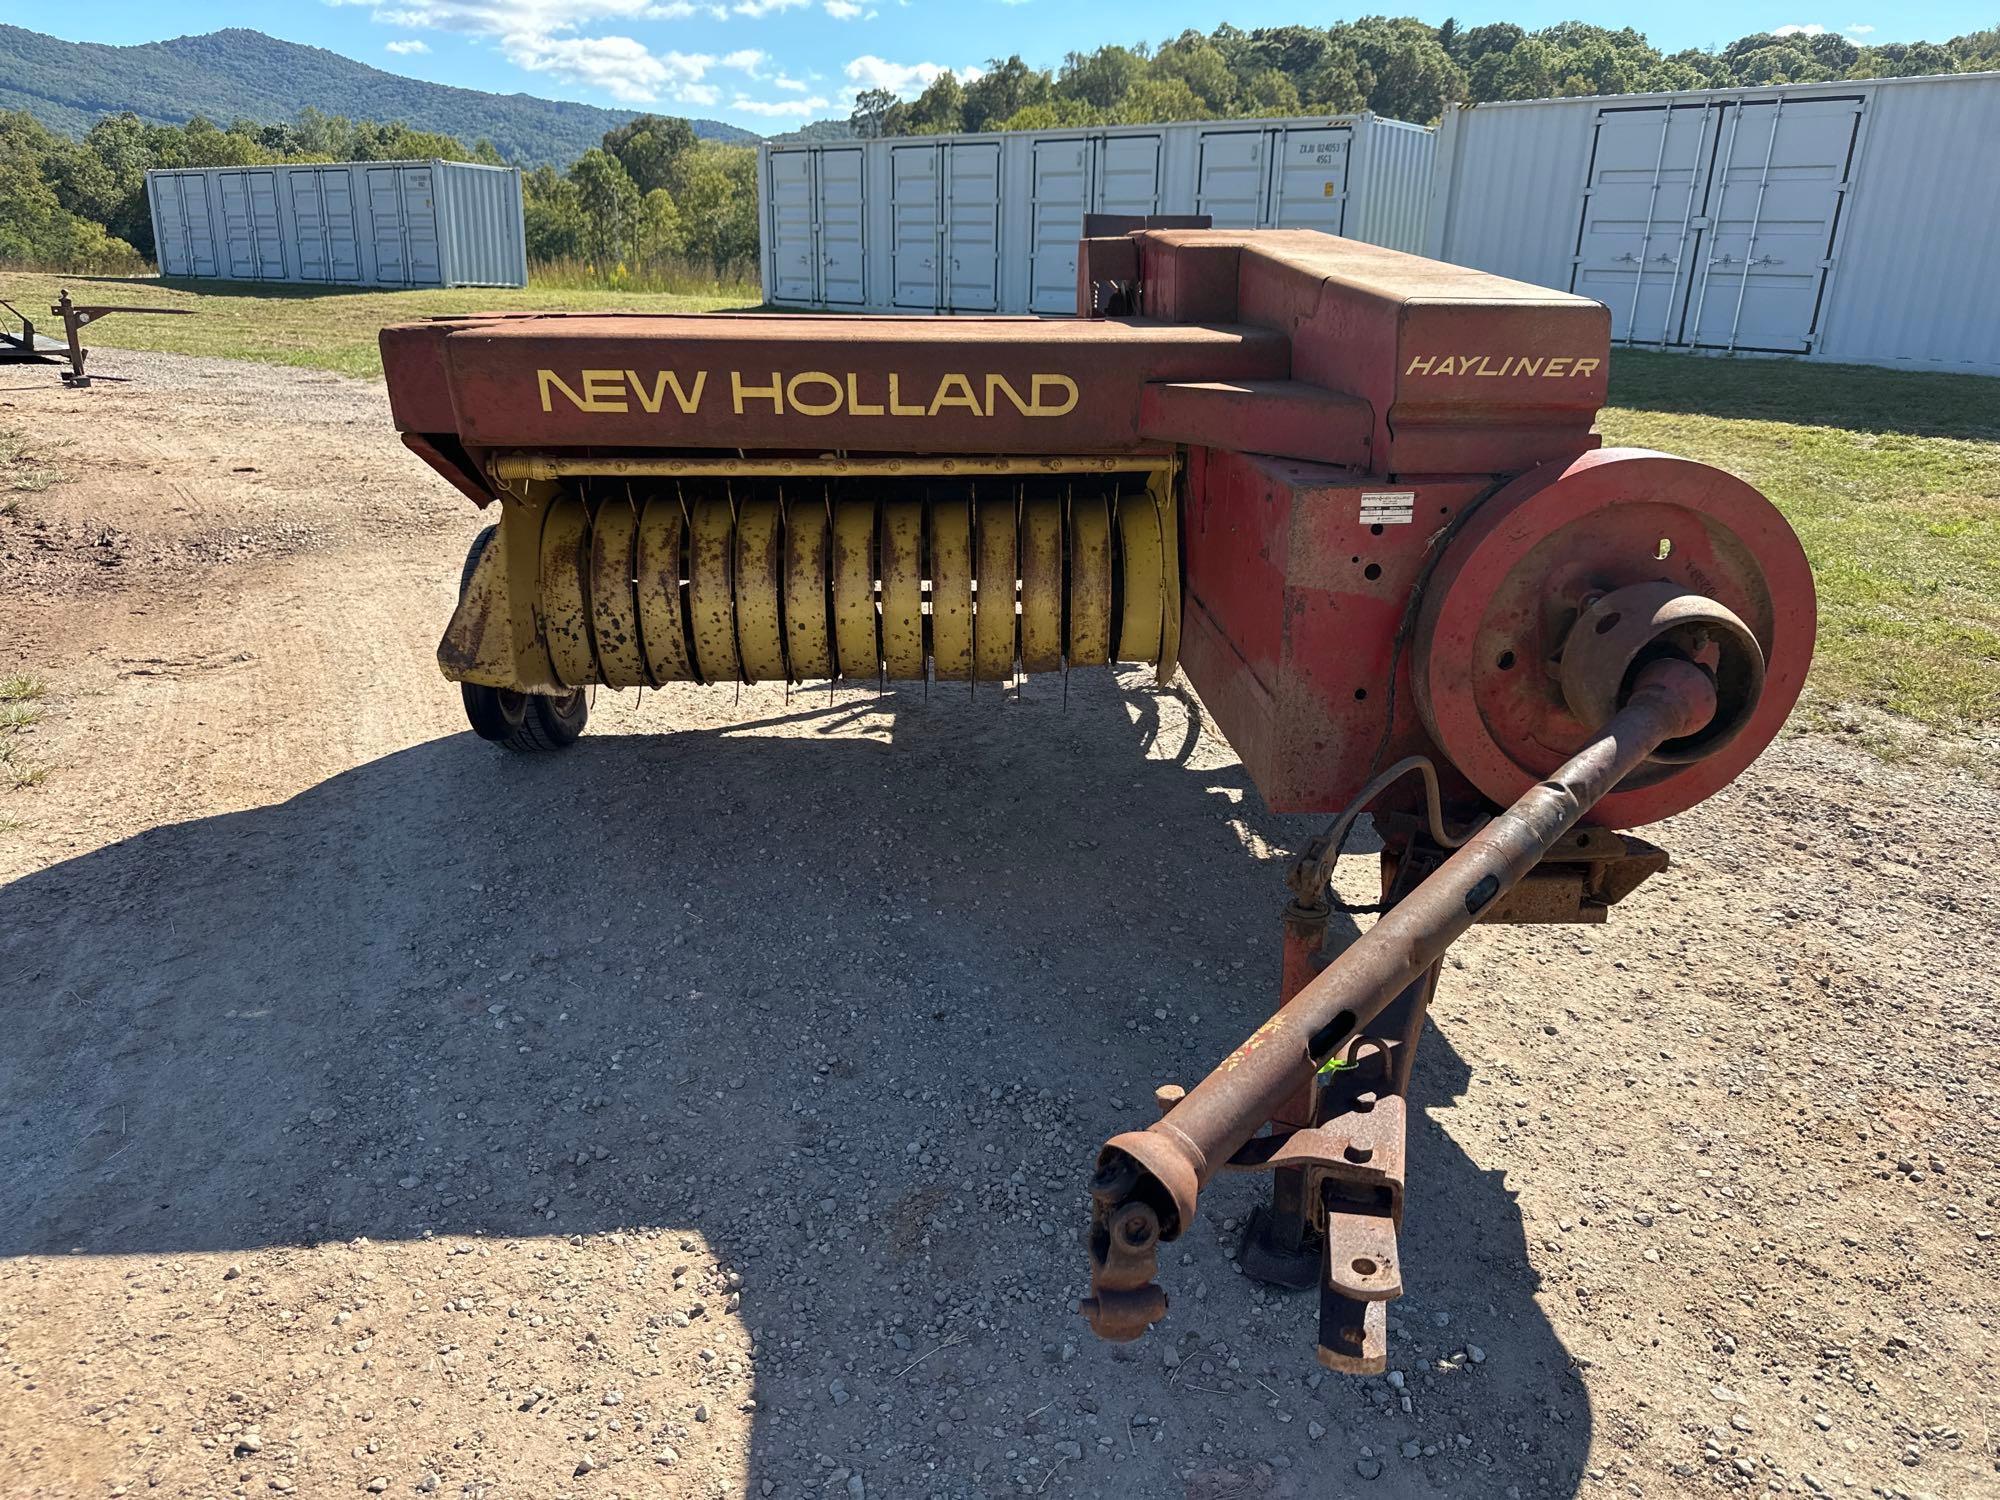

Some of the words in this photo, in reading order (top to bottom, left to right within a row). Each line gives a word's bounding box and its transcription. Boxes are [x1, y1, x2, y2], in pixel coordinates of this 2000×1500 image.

[1405, 355, 1601, 377] HAYLINER
[536, 369, 707, 414] NEW
[731, 371, 1079, 417] HOLLAND
